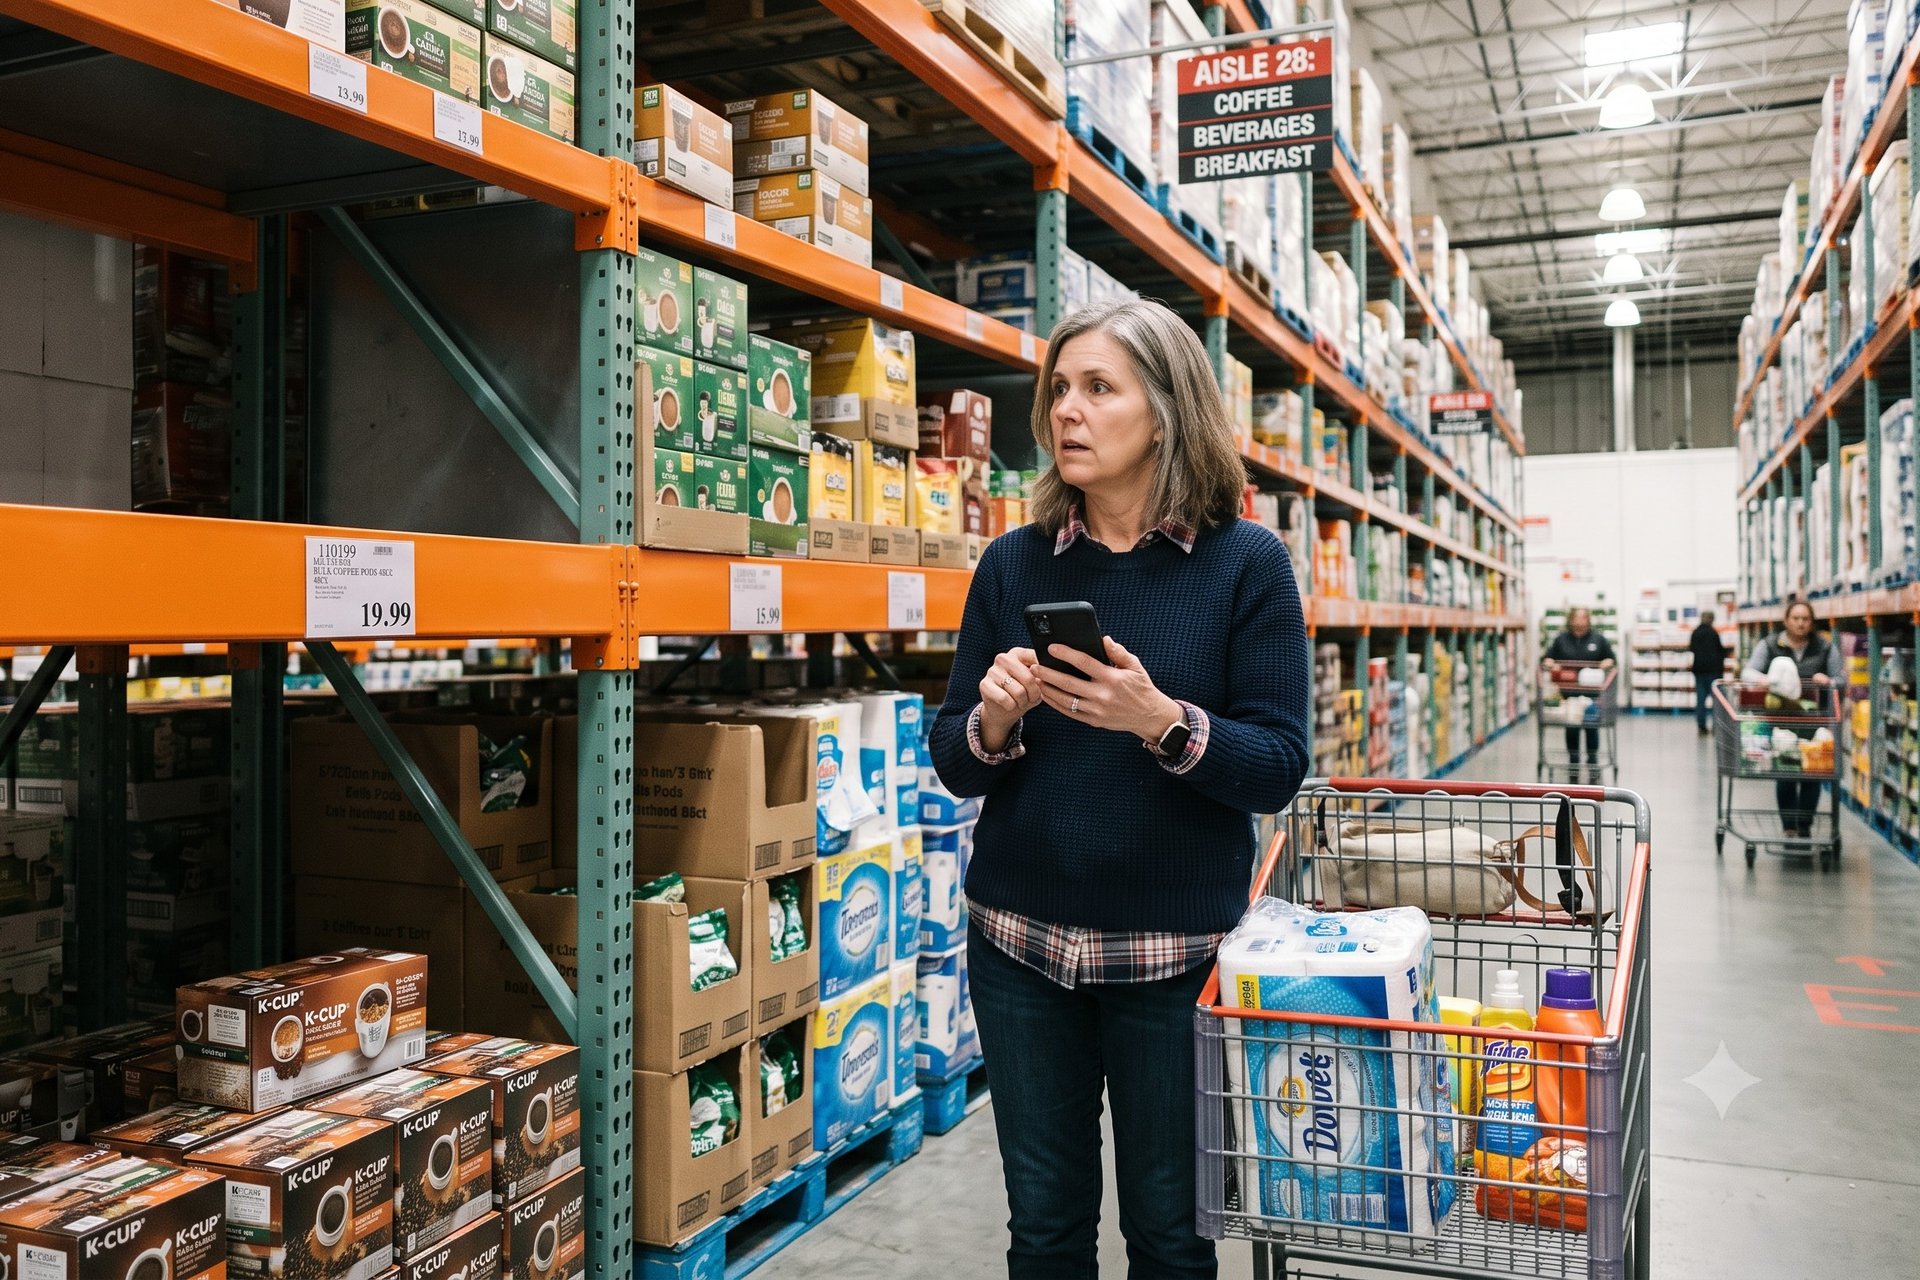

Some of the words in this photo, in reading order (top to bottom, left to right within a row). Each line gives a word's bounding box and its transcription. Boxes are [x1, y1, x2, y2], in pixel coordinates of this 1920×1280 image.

[1193, 52, 1269, 87] AISLE
[1275, 46, 1316, 77] 28:
[337, 85, 364, 106] 13.99
[1213, 85, 1294, 115] COFFEE
[1193, 113, 1316, 148] BEVERAGES
[1194, 144, 1316, 178] BREAKFAST
[319, 544, 357, 559] 110199
[361, 568, 378, 577] PODS
[361, 602, 411, 628] 19.99
[756, 607, 780, 625] 15.99
[654, 785, 683, 798] Pods
